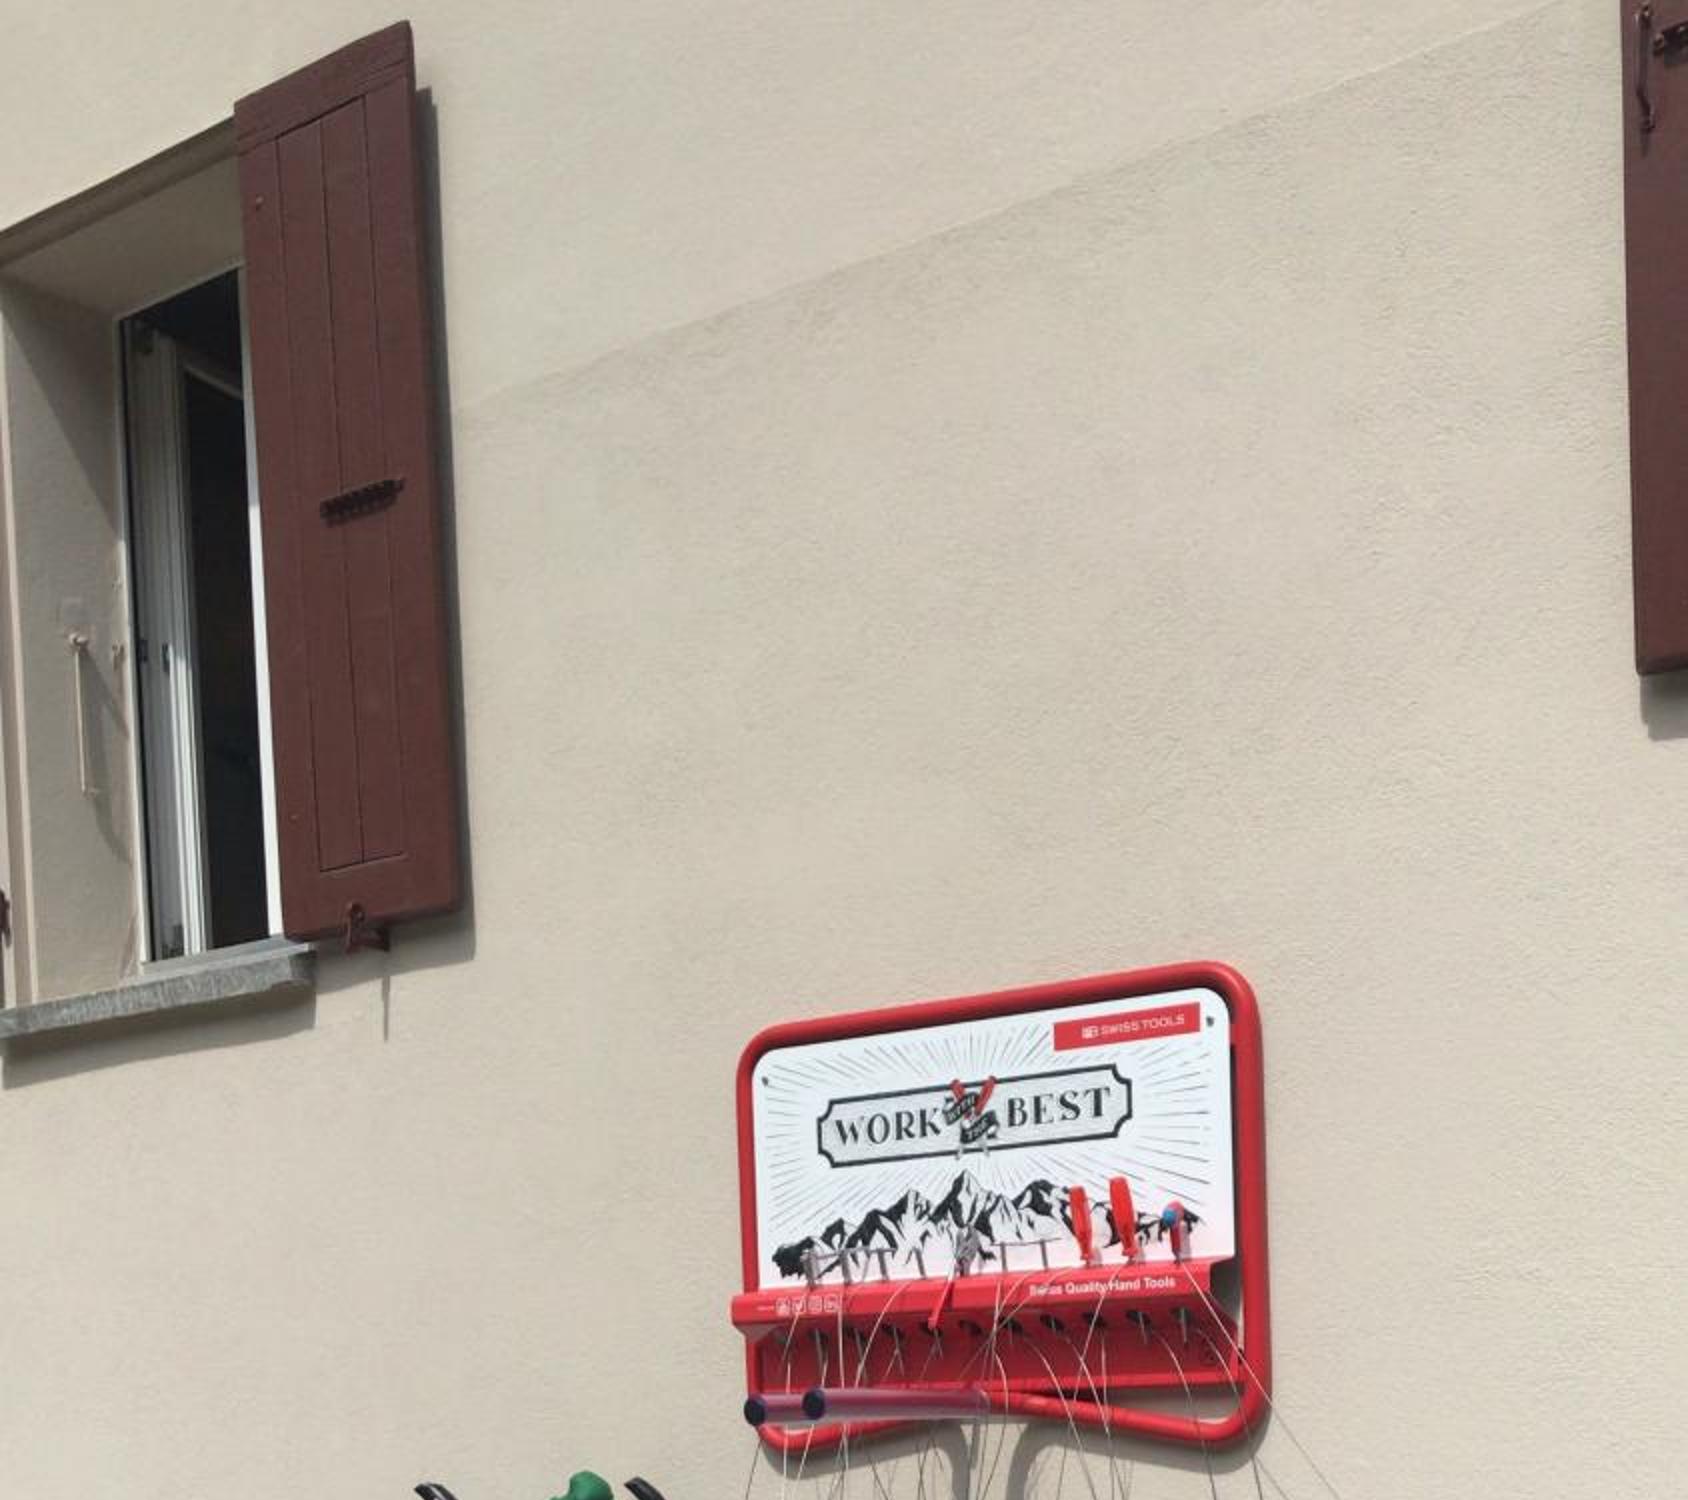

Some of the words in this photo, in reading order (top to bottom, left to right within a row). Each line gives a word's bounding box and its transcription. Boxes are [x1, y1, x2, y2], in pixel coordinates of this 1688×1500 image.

[1101, 1020, 1140, 1036] SWISS
[1141, 1013, 1185, 1031] TOOLS
[835, 1106, 942, 1147] WORK
[1007, 1086, 1113, 1129] BEST
[1065, 1280, 1108, 1296] Quality
[1109, 1278, 1141, 1292] Hand
[1144, 1276, 1176, 1289] Tools
